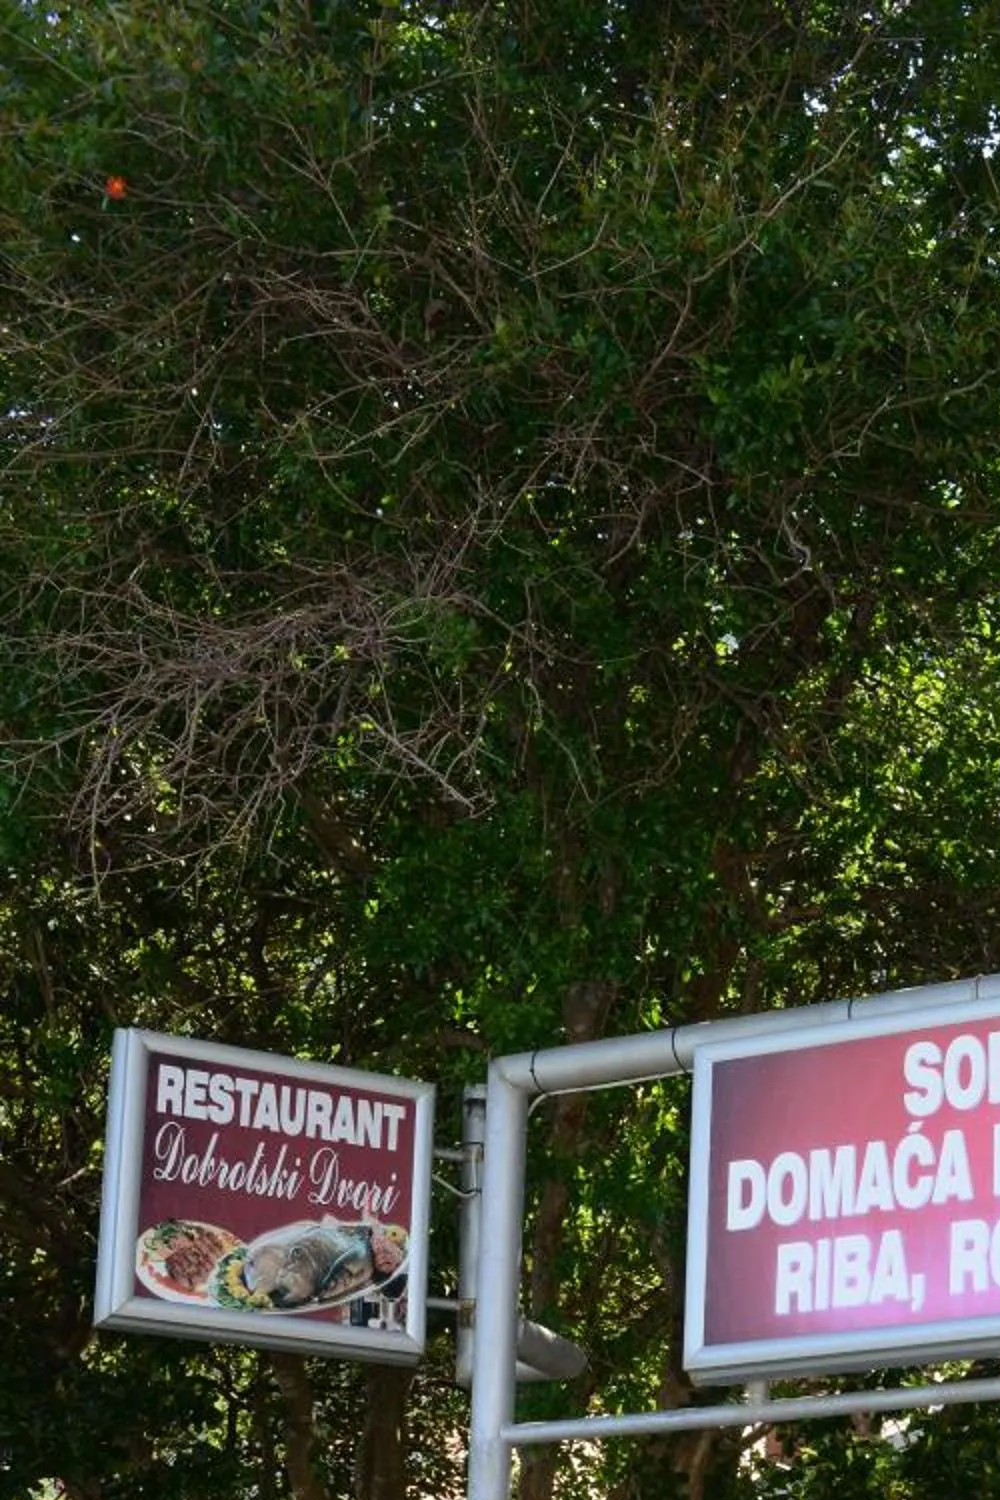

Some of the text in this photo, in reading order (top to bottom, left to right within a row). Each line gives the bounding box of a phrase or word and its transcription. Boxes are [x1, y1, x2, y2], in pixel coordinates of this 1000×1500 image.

[156, 1064, 405, 1151] RESTAURANT
[153, 1121, 400, 1214] Dobrotski Dvori
[726, 1121, 973, 1231] DOMAĆA
[775, 1232, 925, 1315] RIBA,
